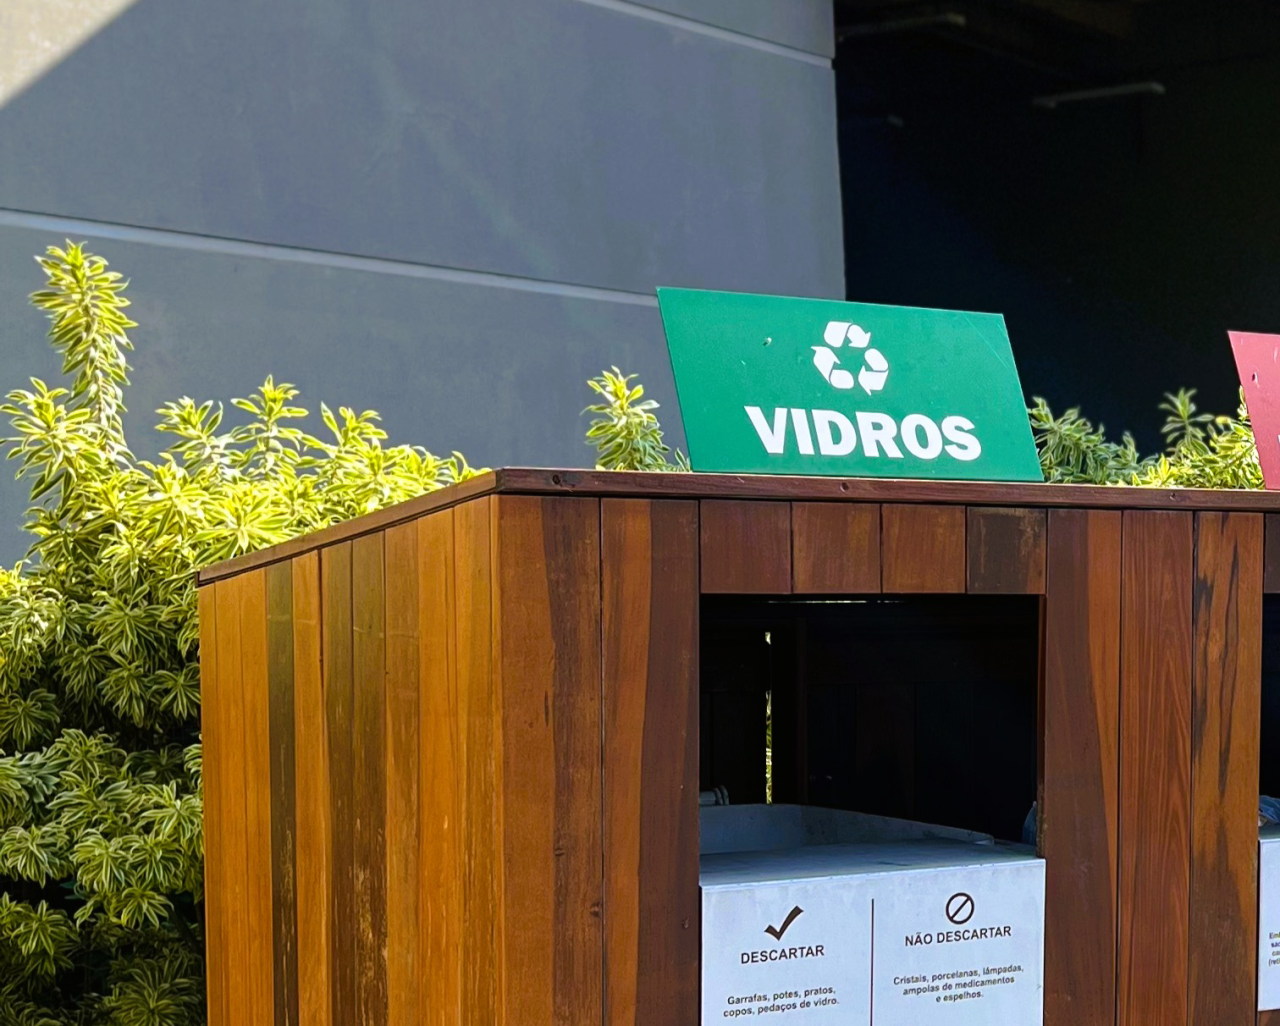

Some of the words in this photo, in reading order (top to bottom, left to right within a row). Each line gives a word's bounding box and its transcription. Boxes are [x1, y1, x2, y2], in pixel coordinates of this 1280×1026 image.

[744, 405, 982, 461] VIDROS
[905, 932, 933, 947] NÃO
[936, 926, 1012, 944] DESCARTAR
[741, 945, 825, 964] DESCARTAR
[893, 975, 929, 985] Cristais,
[931, 970, 981, 983] porcelanas,
[902, 985, 940, 996] ampolas
[941, 983, 953, 991] de
[954, 976, 1015, 990] medicamentos
[727, 993, 770, 1005] Garrafas,
[772, 990, 801, 1001] potes,
[803, 987, 836, 998] pratos,
[943, 991, 984, 1002] espelhos.
[723, 1007, 755, 1018] copos,
[757, 1003, 797, 1015] pedaços
[799, 1000, 811, 1009] de
[813, 997, 840, 1007] vidro.
